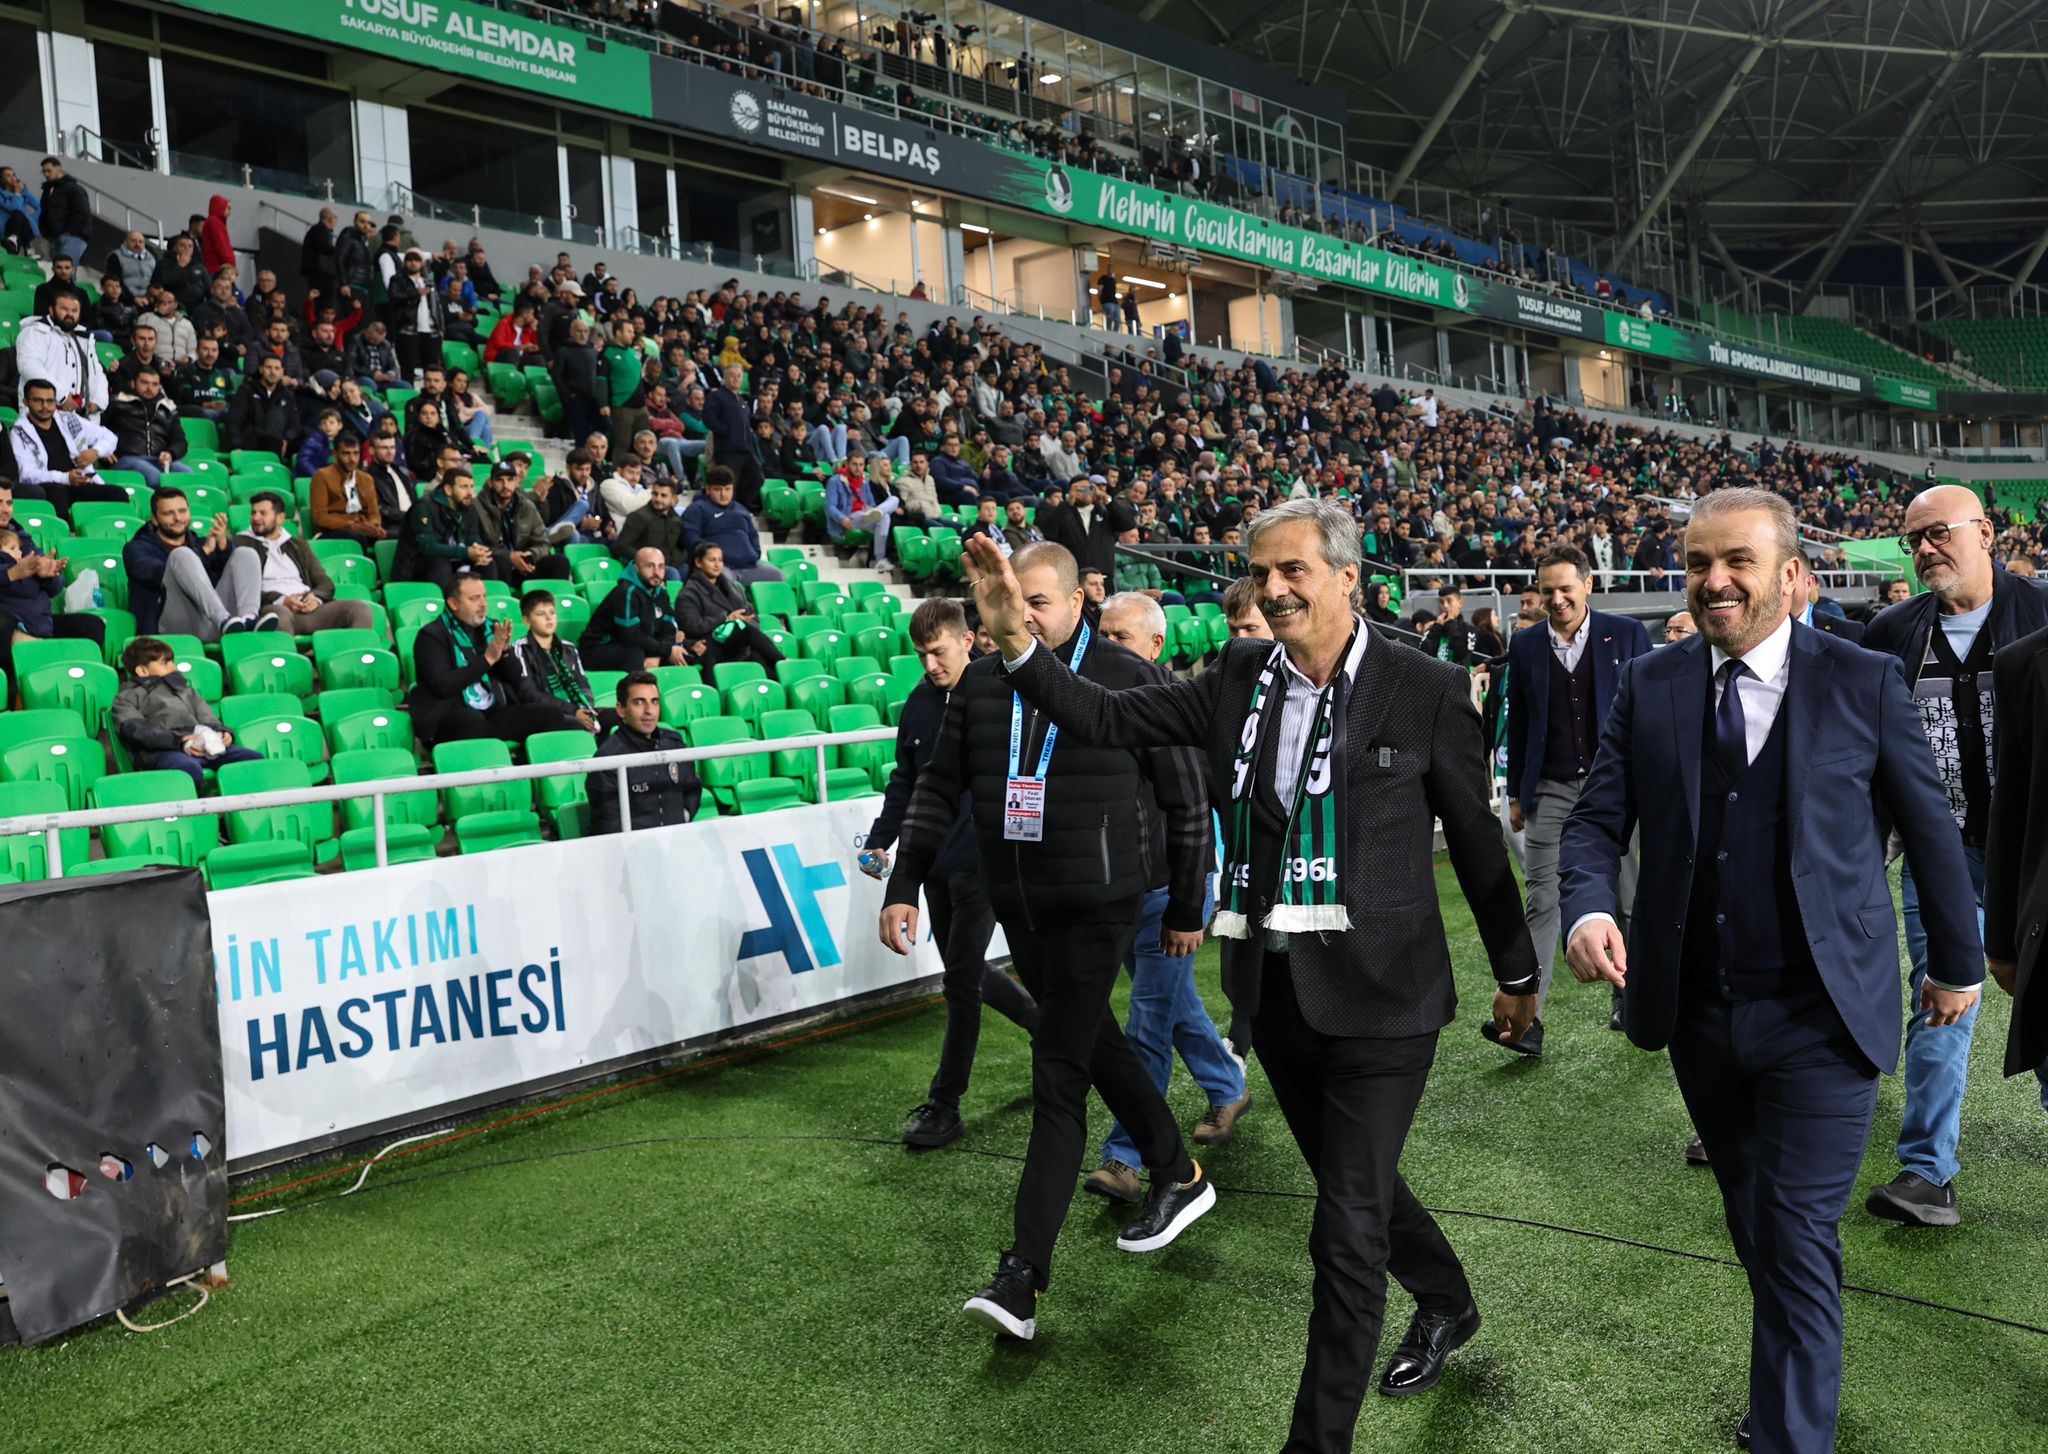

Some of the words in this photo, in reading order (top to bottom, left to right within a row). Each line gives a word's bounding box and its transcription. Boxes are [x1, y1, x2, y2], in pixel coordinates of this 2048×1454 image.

[340, 14, 399, 40] SAKARYA
[401, 30, 475, 59] BÜYÜKŞEHİR
[476, 49, 529, 73] BELEDİYE
[530, 63, 577, 85] BAŞKANI
[445, 12, 576, 66] ALEMDAR
[766, 100, 809, 119] SAKARYA
[844, 125, 941, 176] BELPAŞ
[1098, 181, 1175, 236] Nehrin
[1184, 204, 1294, 264] Çocuklarına
[1300, 235, 1380, 284] Başarılar
[1517, 295, 1544, 314] YUSUF
[1545, 302, 1582, 323] ALEMDAR
[1708, 341, 1729, 365] TÜM
[1012, 717, 1020, 759] TRENDYOL
[1042, 725, 1057, 762] TRENDYO
[214, 934, 282, 1005] İN
[305, 904, 478, 985] TAKIMI
[247, 947, 565, 1081] HASTANESİ
